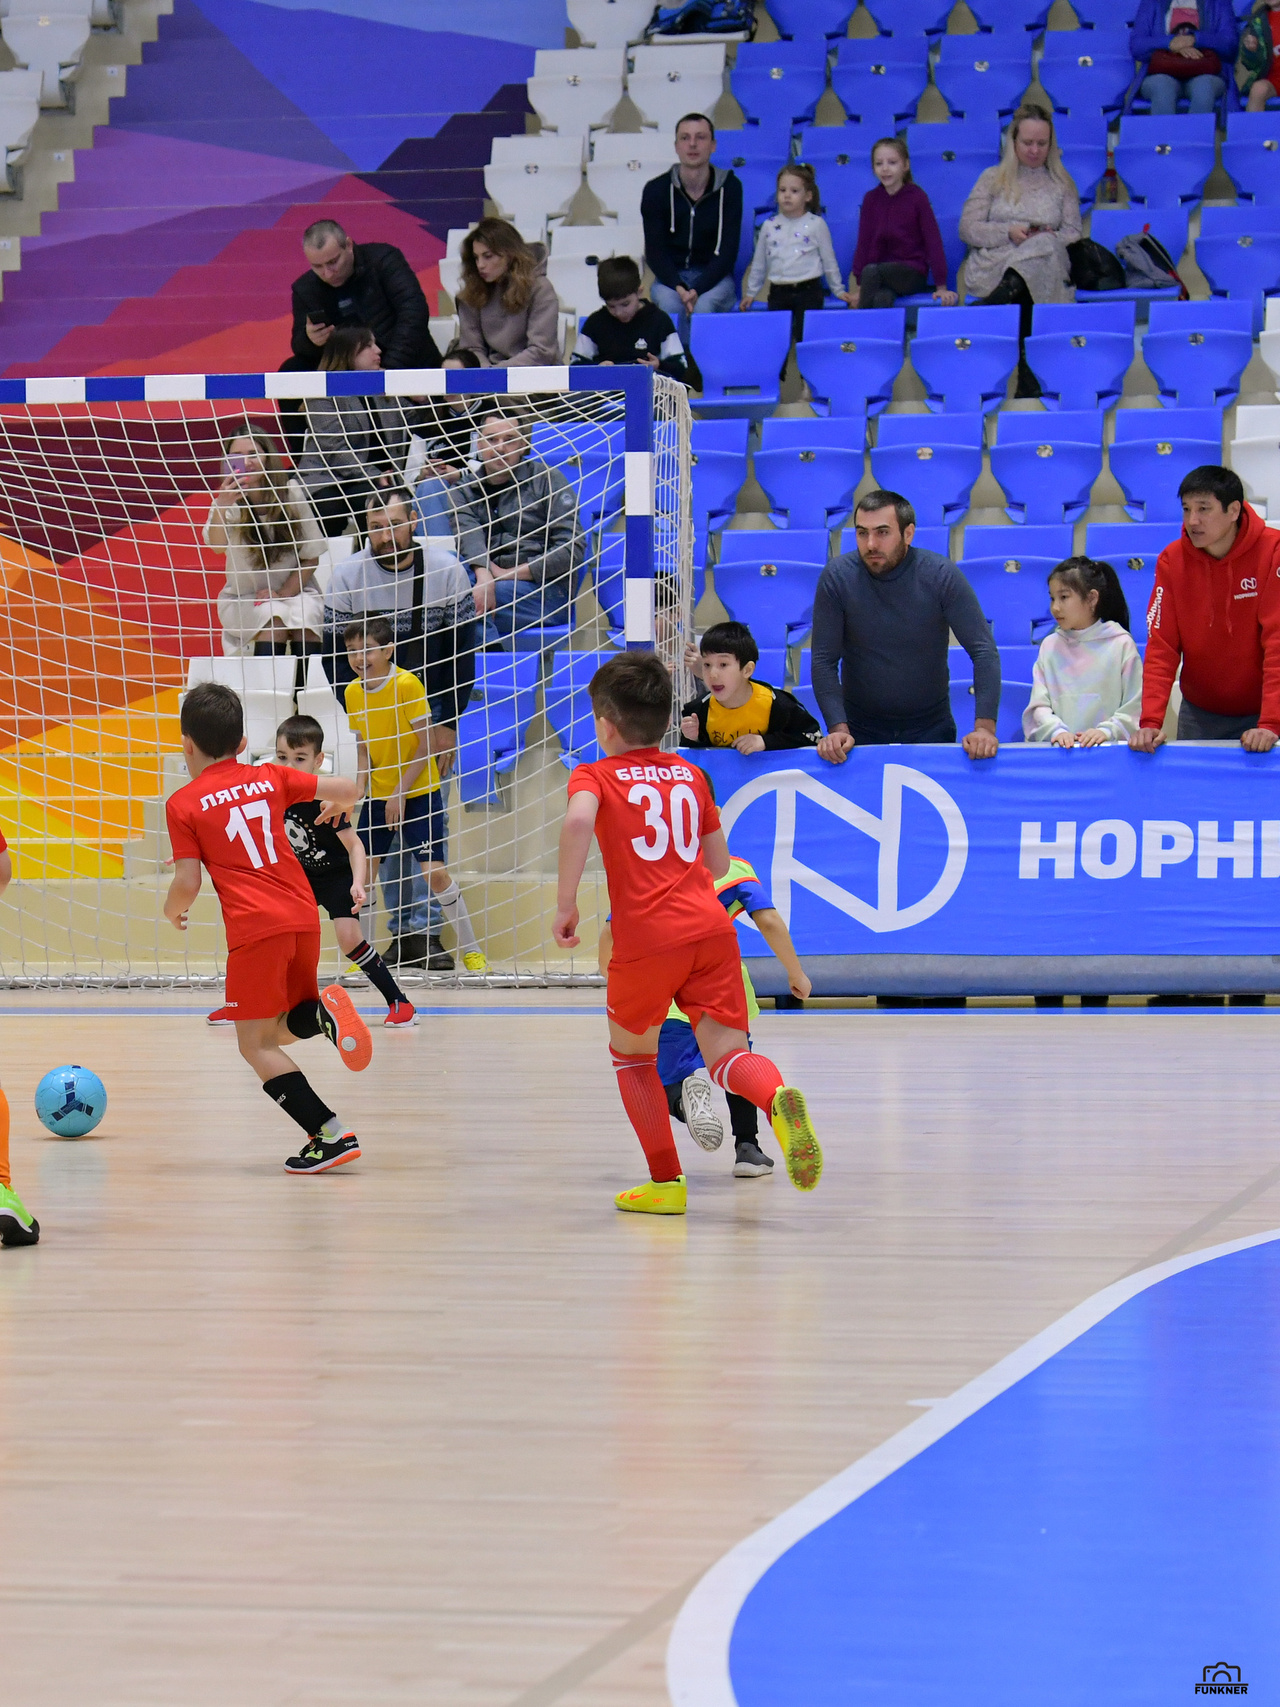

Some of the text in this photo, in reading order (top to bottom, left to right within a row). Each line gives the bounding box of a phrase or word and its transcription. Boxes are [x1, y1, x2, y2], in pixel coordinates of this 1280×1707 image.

[199, 780, 275, 812] ЛЯГИН
[615, 765, 694, 783] БЕДОЕВ
[224, 799, 279, 870] 17
[627, 783, 699, 863] 30
